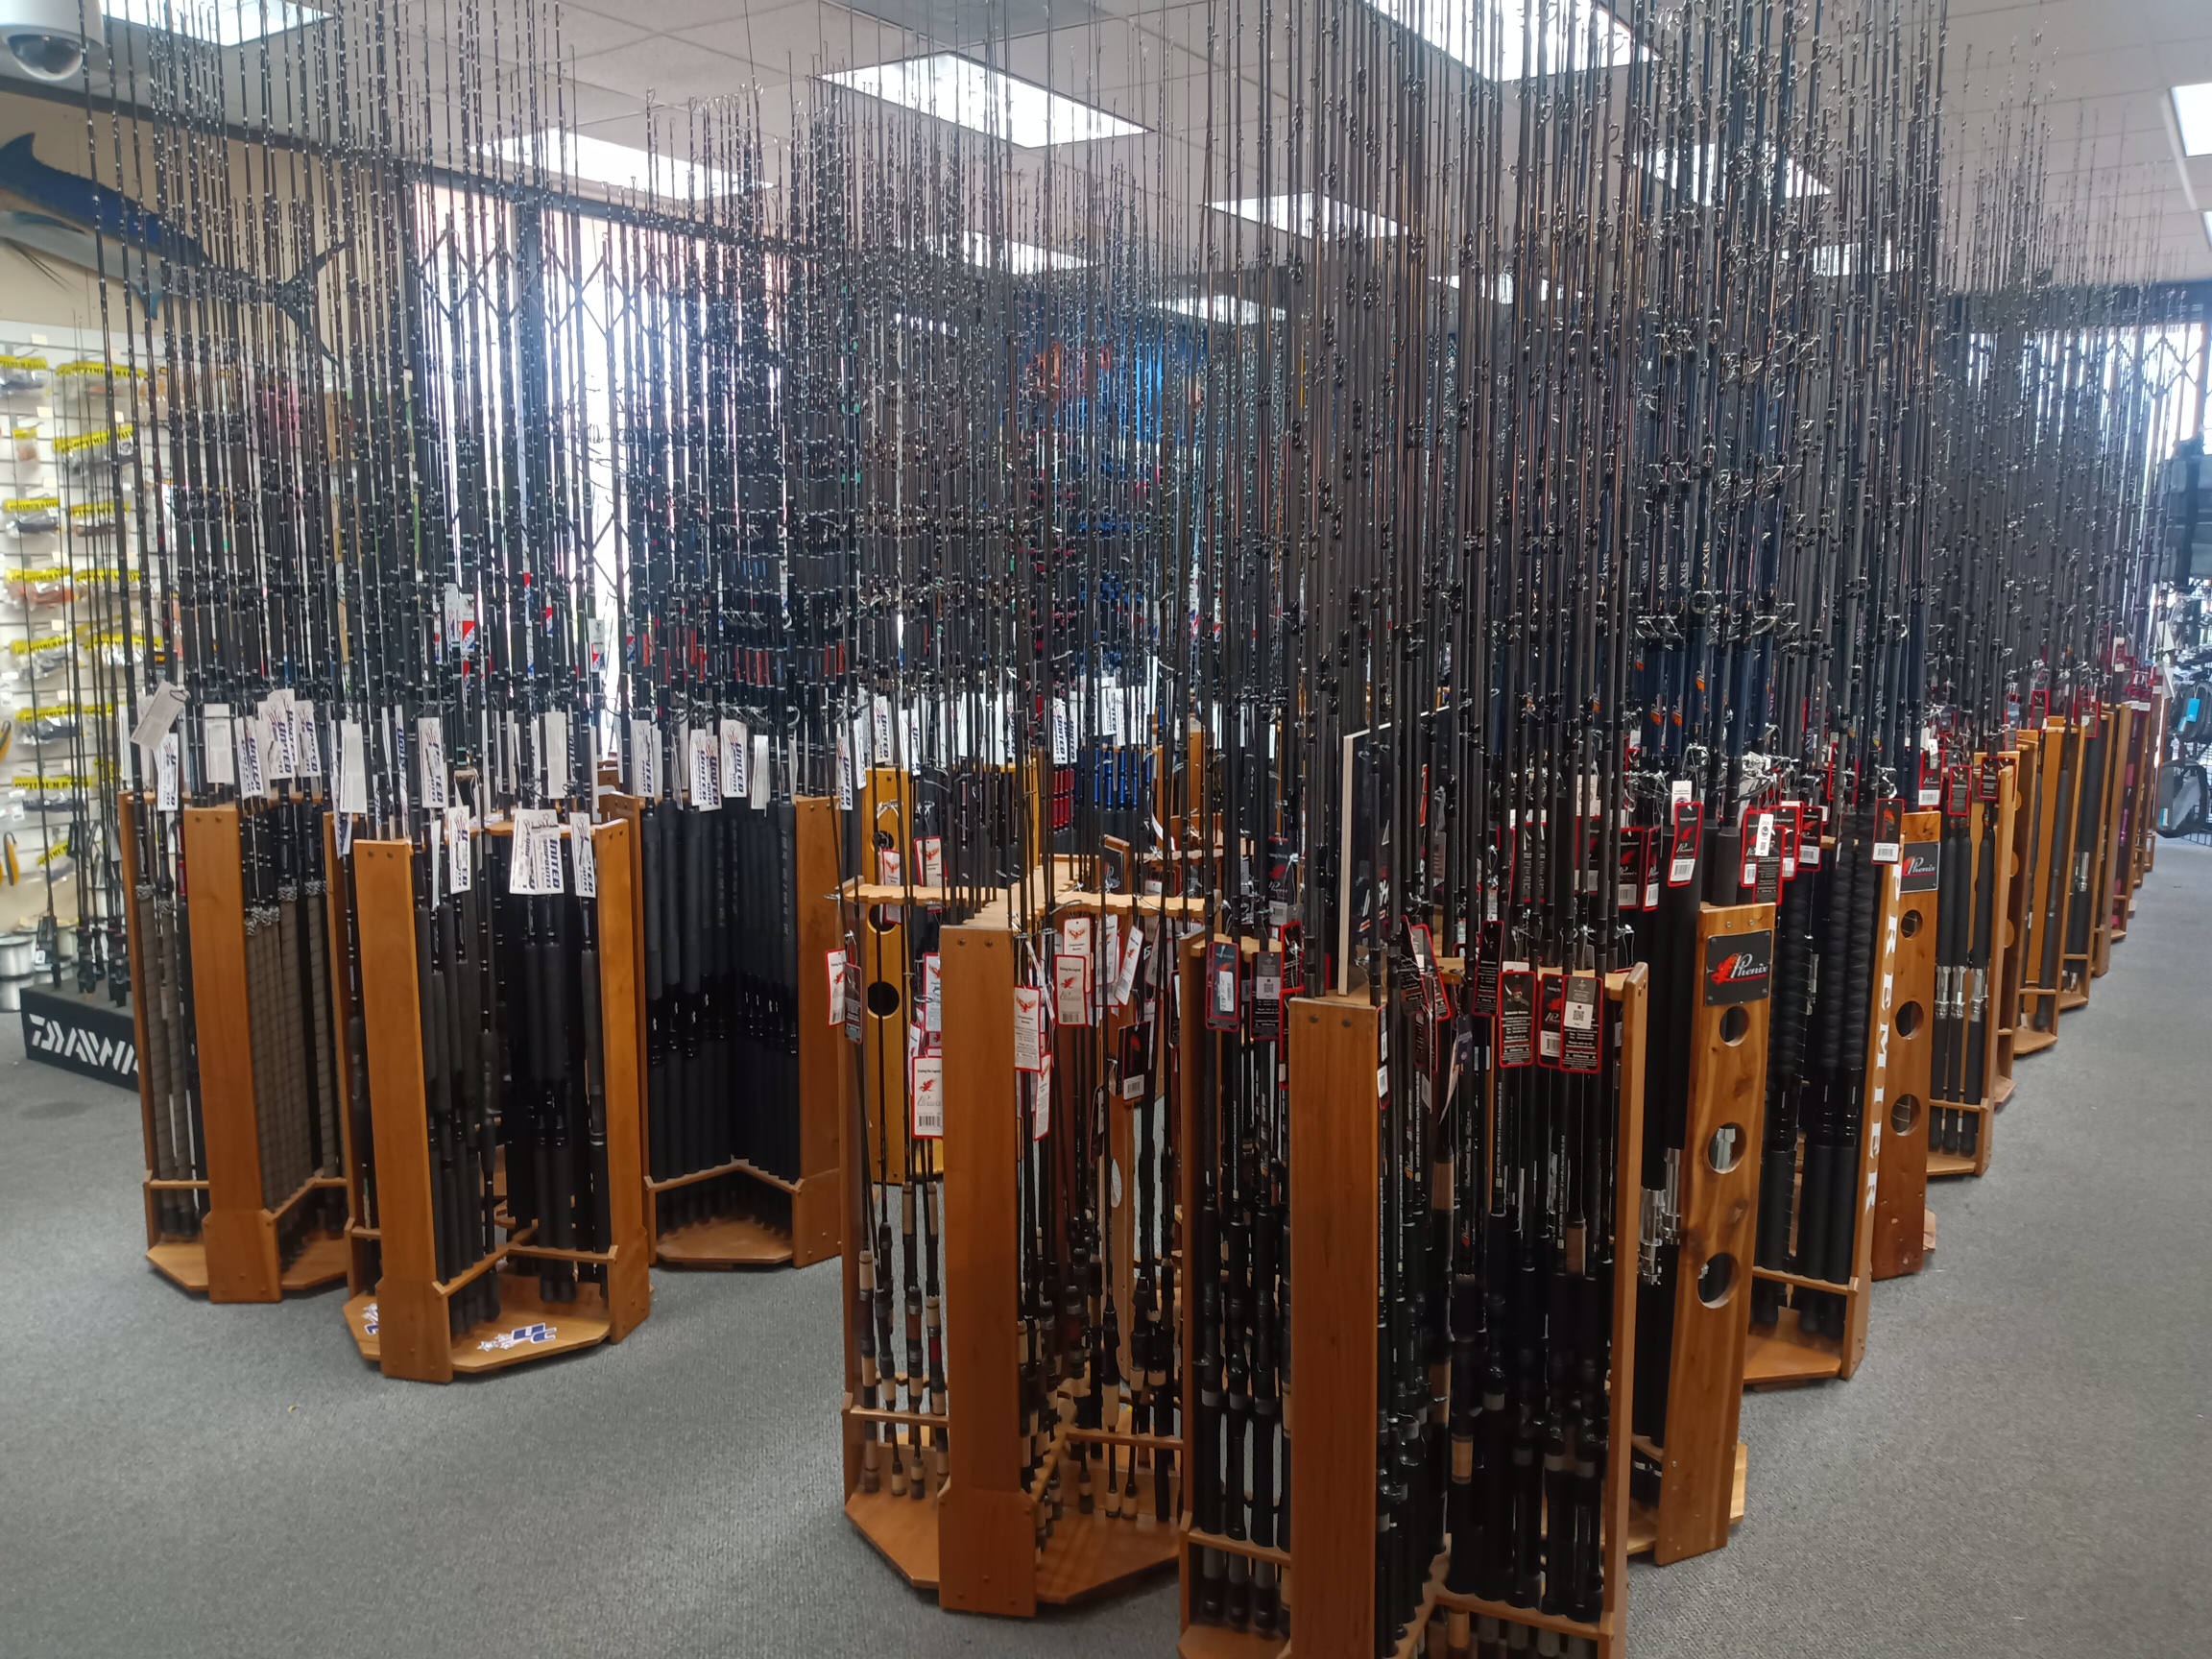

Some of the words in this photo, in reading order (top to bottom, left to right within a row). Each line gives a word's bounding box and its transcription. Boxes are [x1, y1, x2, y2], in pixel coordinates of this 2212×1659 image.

[735, 742, 745, 794] UNITED
[1907, 856, 1936, 876] Phenix
[1729, 952, 1768, 979] Phenix
